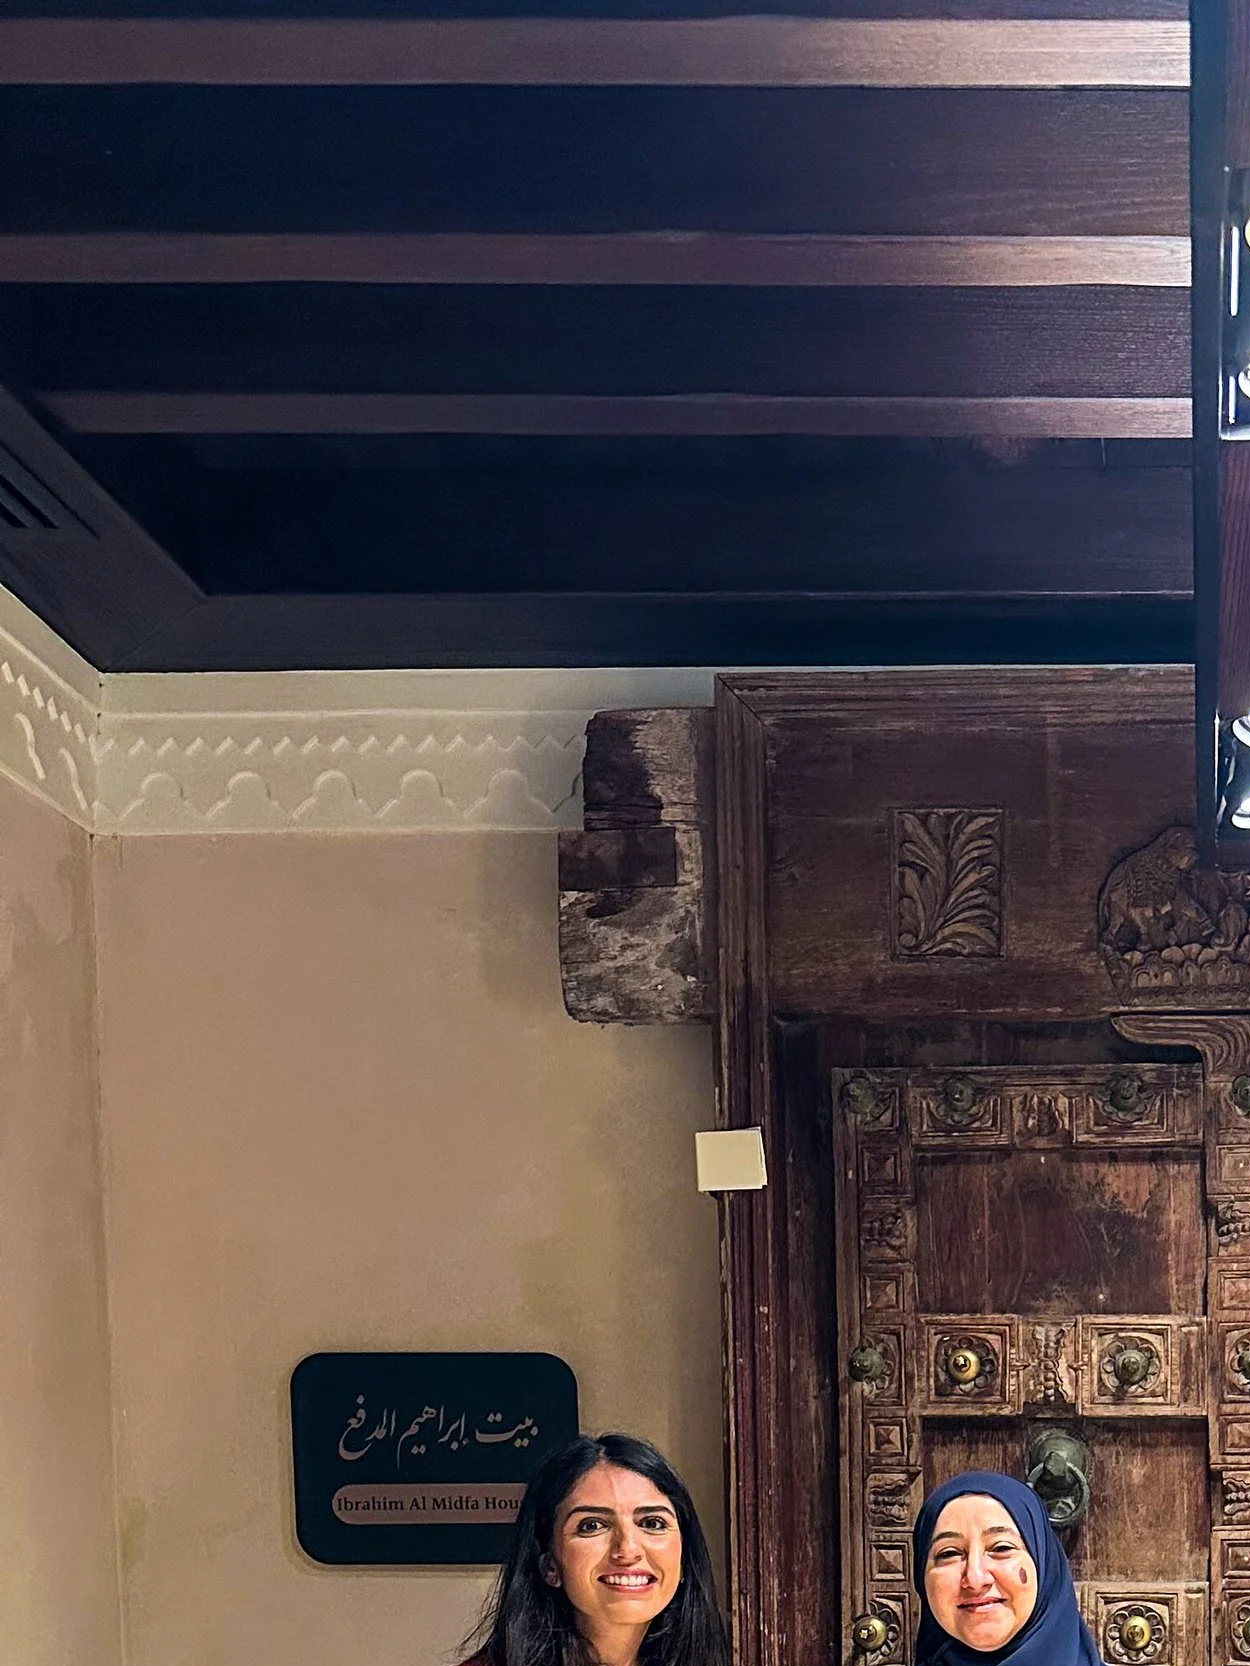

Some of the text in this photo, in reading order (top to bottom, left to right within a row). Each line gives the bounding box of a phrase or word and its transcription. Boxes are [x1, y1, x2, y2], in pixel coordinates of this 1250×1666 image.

[337, 1394, 396, 1461] المدفع
[474, 1412, 539, 1448] بيت
[336, 1496, 519, 1512] Ibrahim Al Midfa Hou
